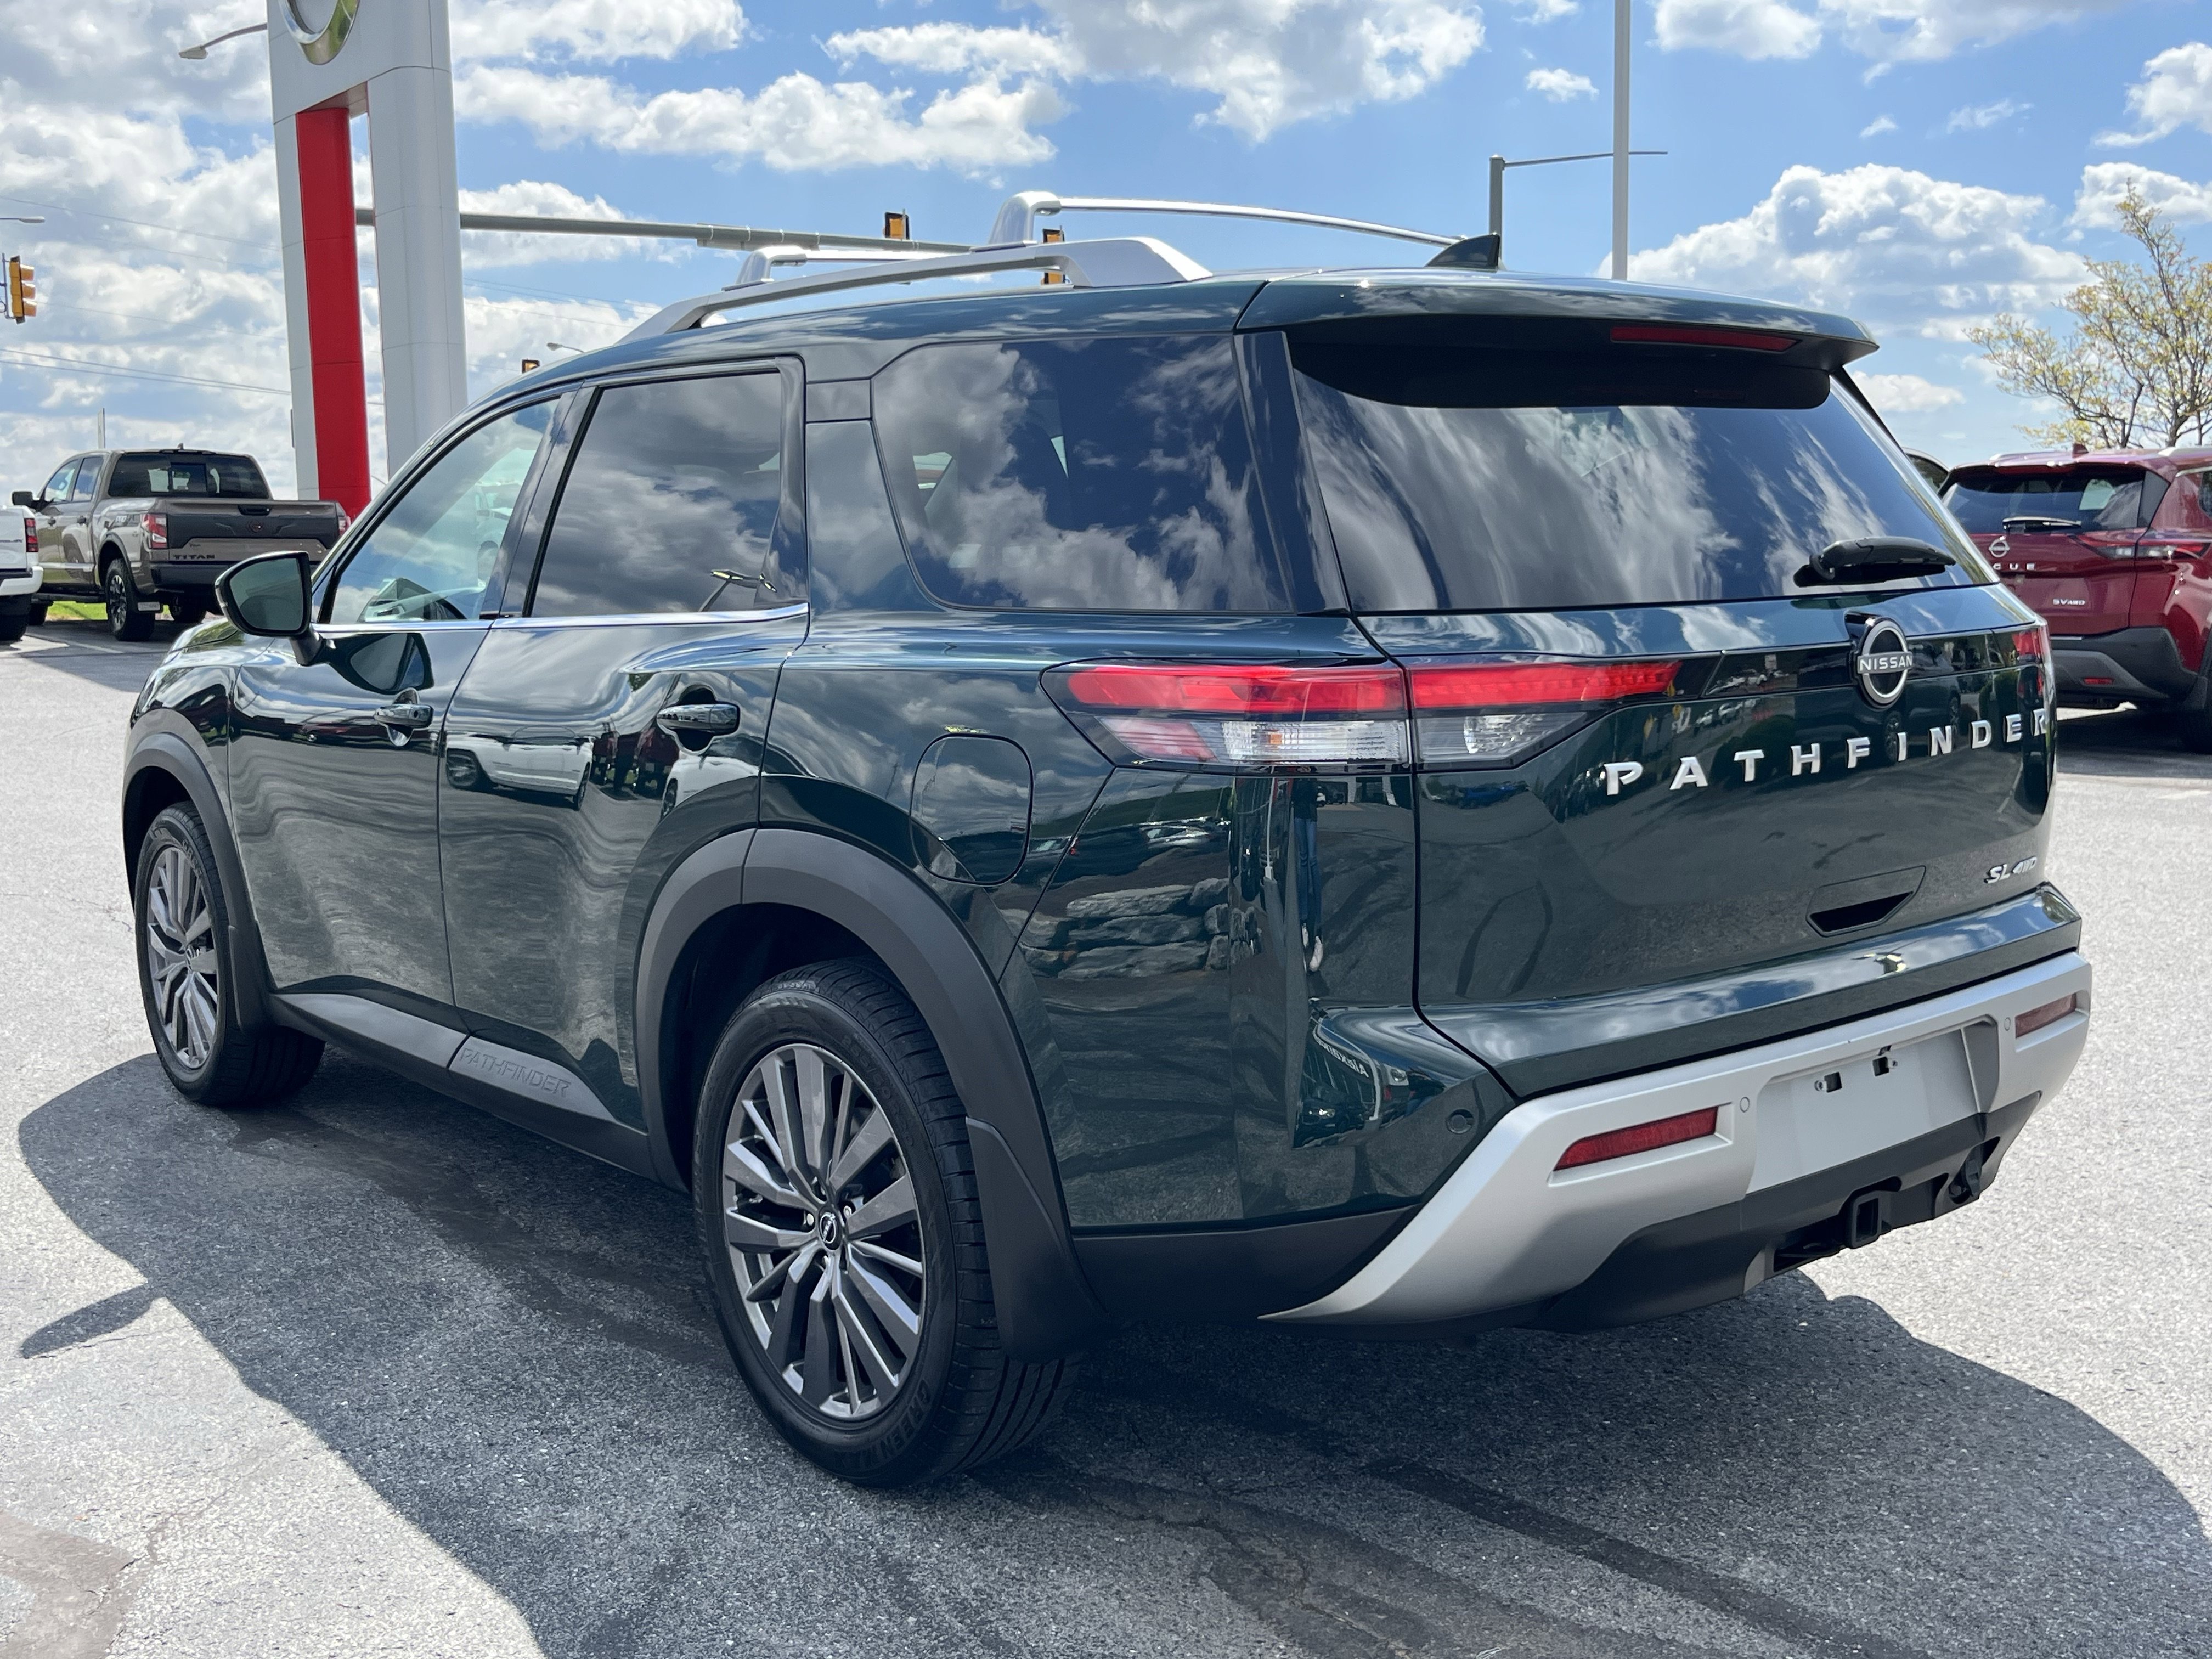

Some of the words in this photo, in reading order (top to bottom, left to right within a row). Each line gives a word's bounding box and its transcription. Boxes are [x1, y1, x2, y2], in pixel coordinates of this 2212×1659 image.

[1993, 562, 2036, 571] GUE
[1859, 654, 1913, 672] NISSAN
[1602, 708, 2047, 796] PATHFINDER
[1984, 863, 2011, 884] SL
[459, 1047, 572, 1097] PATHFINDER
